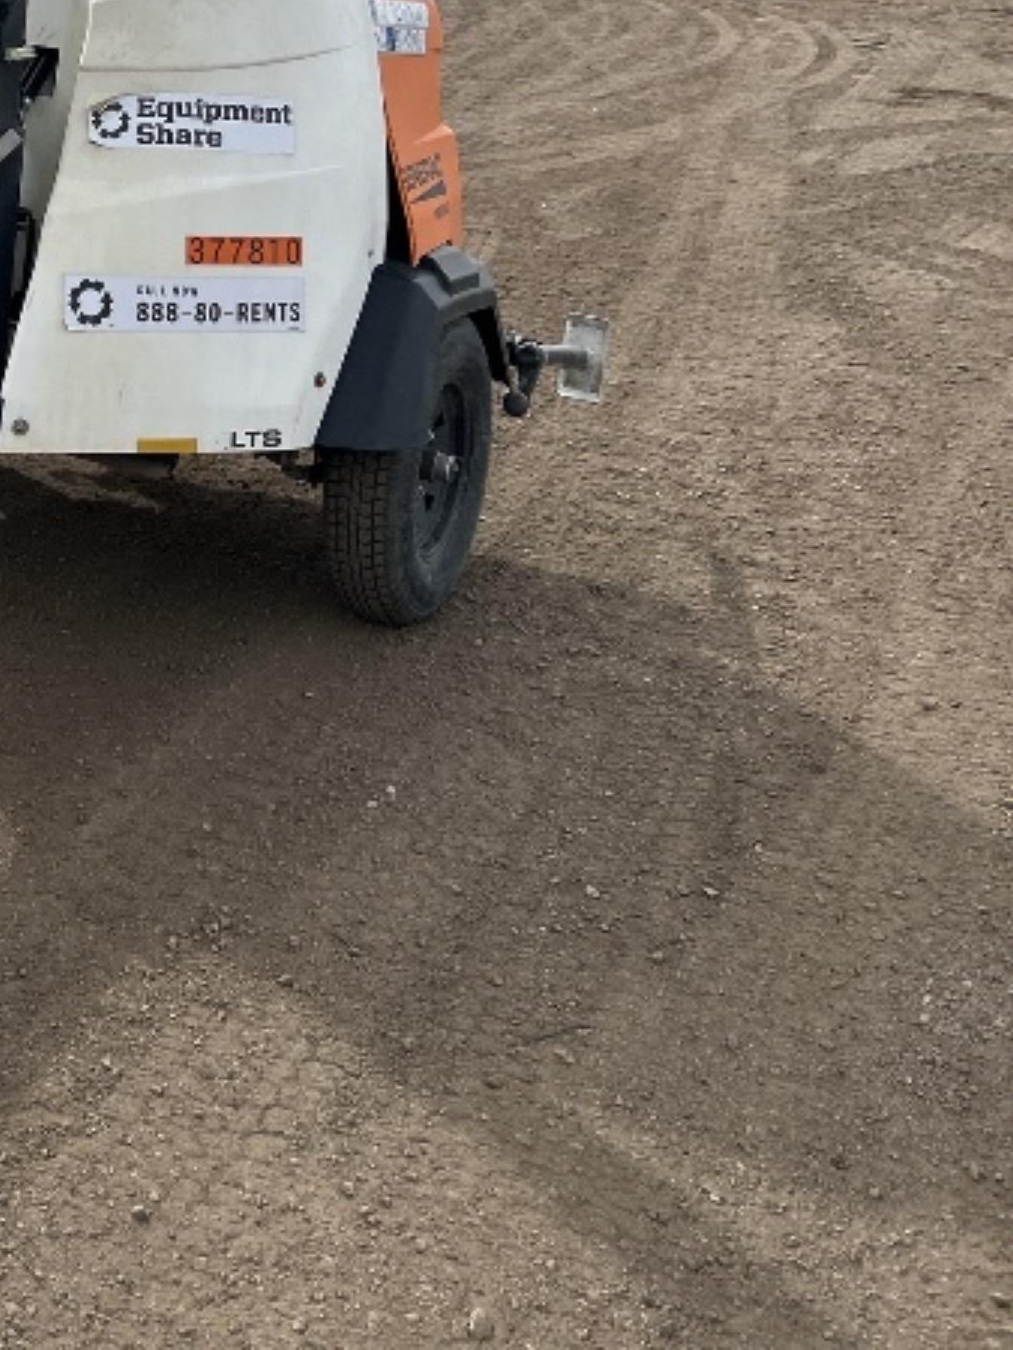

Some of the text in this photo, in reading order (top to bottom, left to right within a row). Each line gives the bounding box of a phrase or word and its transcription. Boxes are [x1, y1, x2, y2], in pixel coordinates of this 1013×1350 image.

[136, 97, 293, 124] Equipment
[136, 122, 223, 148] Share
[189, 236, 301, 265] 377810
[135, 302, 301, 323] 888-80-RENTS
